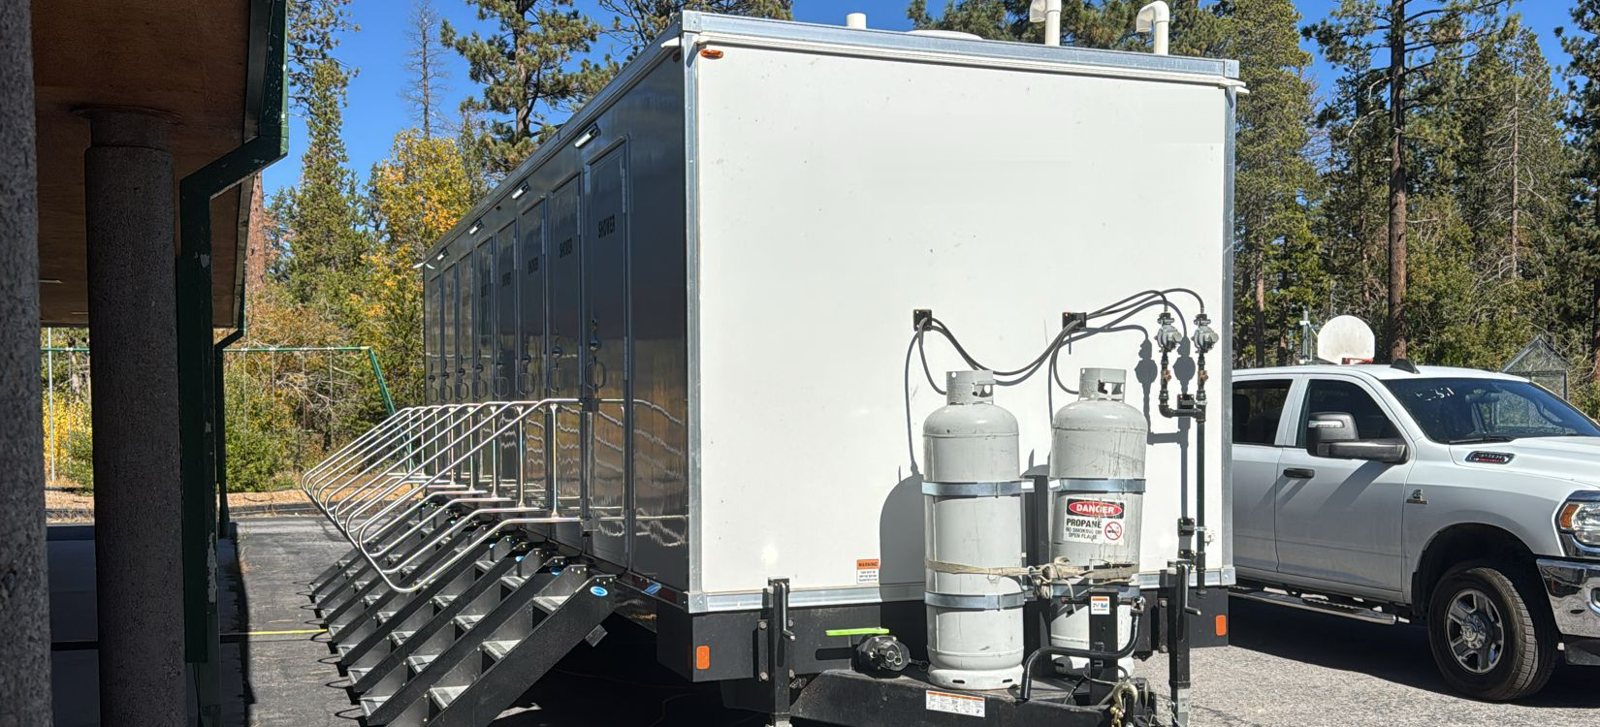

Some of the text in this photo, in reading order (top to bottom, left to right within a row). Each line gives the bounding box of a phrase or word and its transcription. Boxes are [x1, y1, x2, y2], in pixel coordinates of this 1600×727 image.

[598, 214, 615, 239] SHOWER
[1076, 504, 1114, 513] DANGER
[1066, 518, 1102, 528] PROPANE
